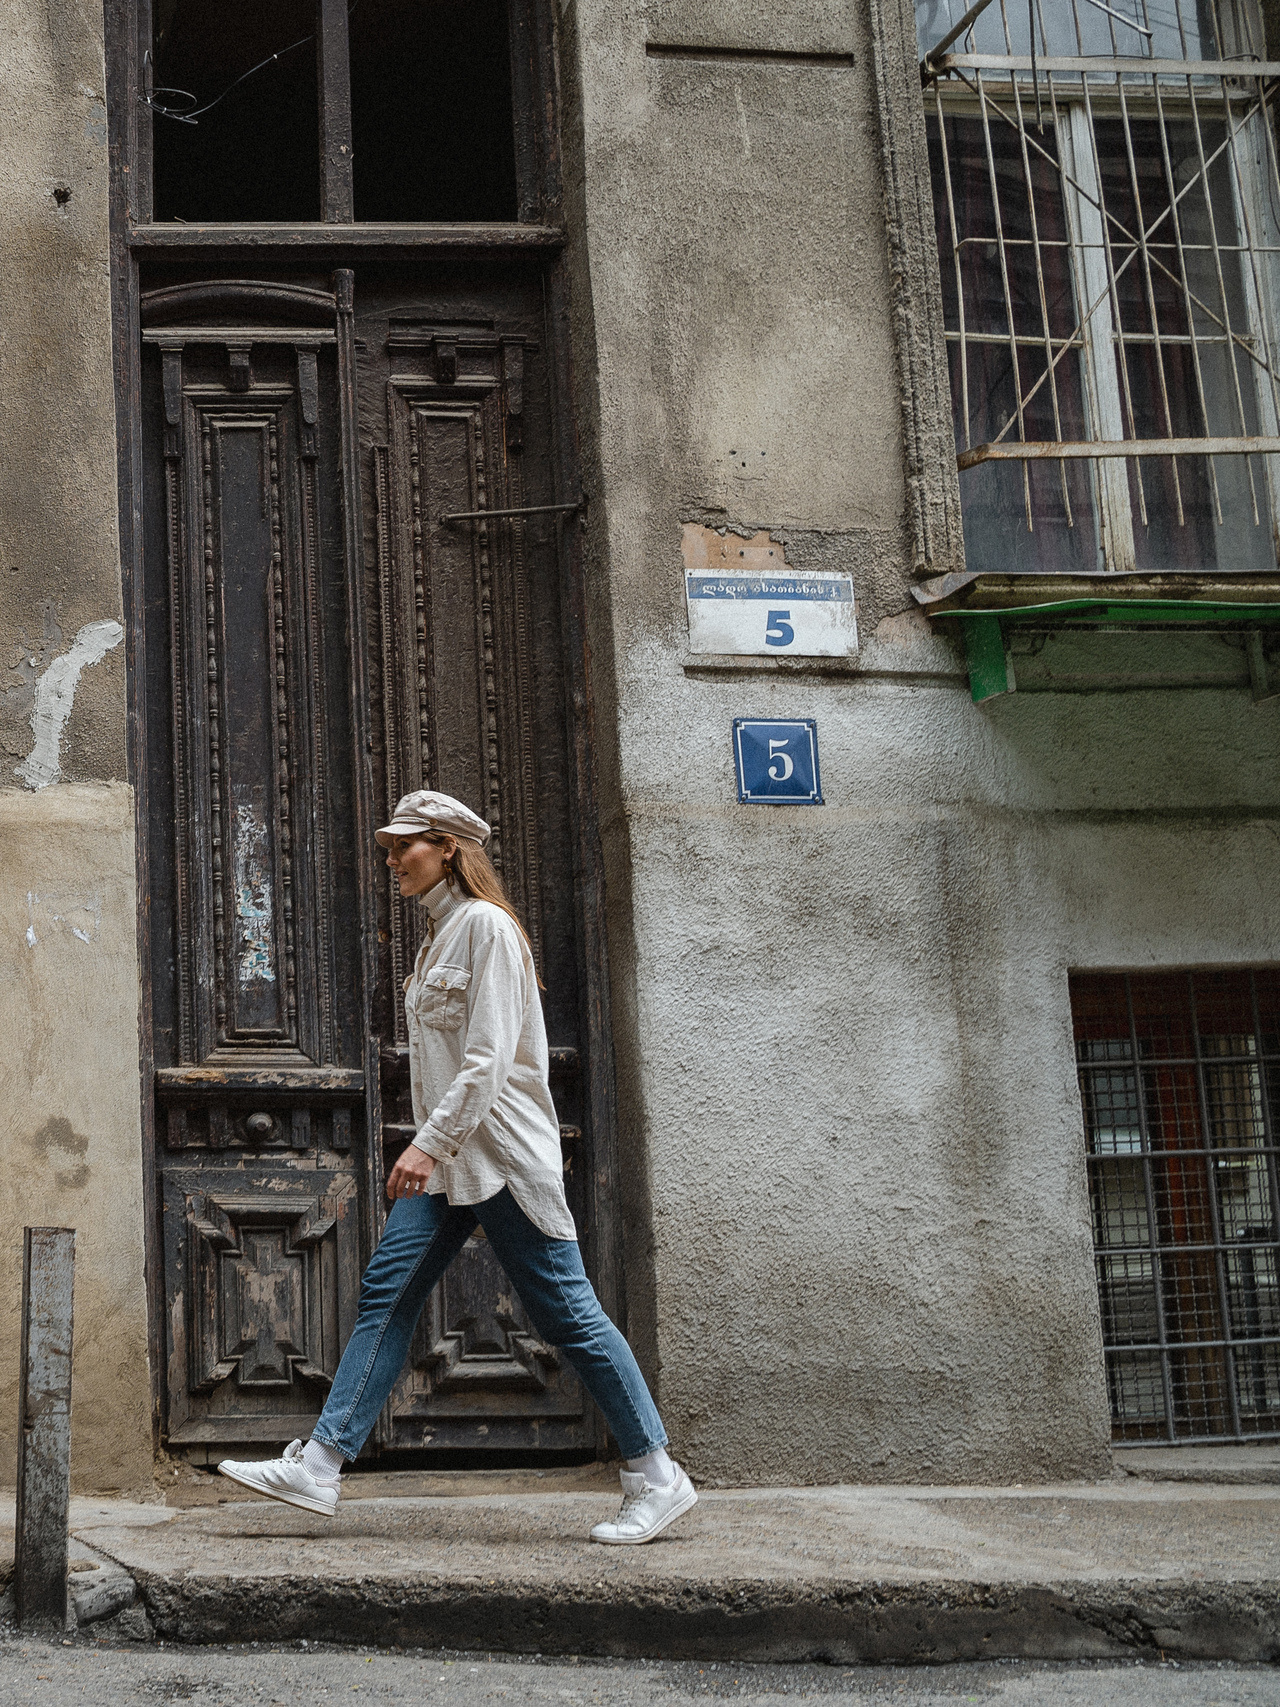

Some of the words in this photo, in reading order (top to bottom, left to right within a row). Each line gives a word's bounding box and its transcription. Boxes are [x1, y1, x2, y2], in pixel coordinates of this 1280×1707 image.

[702, 583, 746, 599] ლადო
[765, 610, 794, 647] 5
[768, 738, 794, 781] 5
